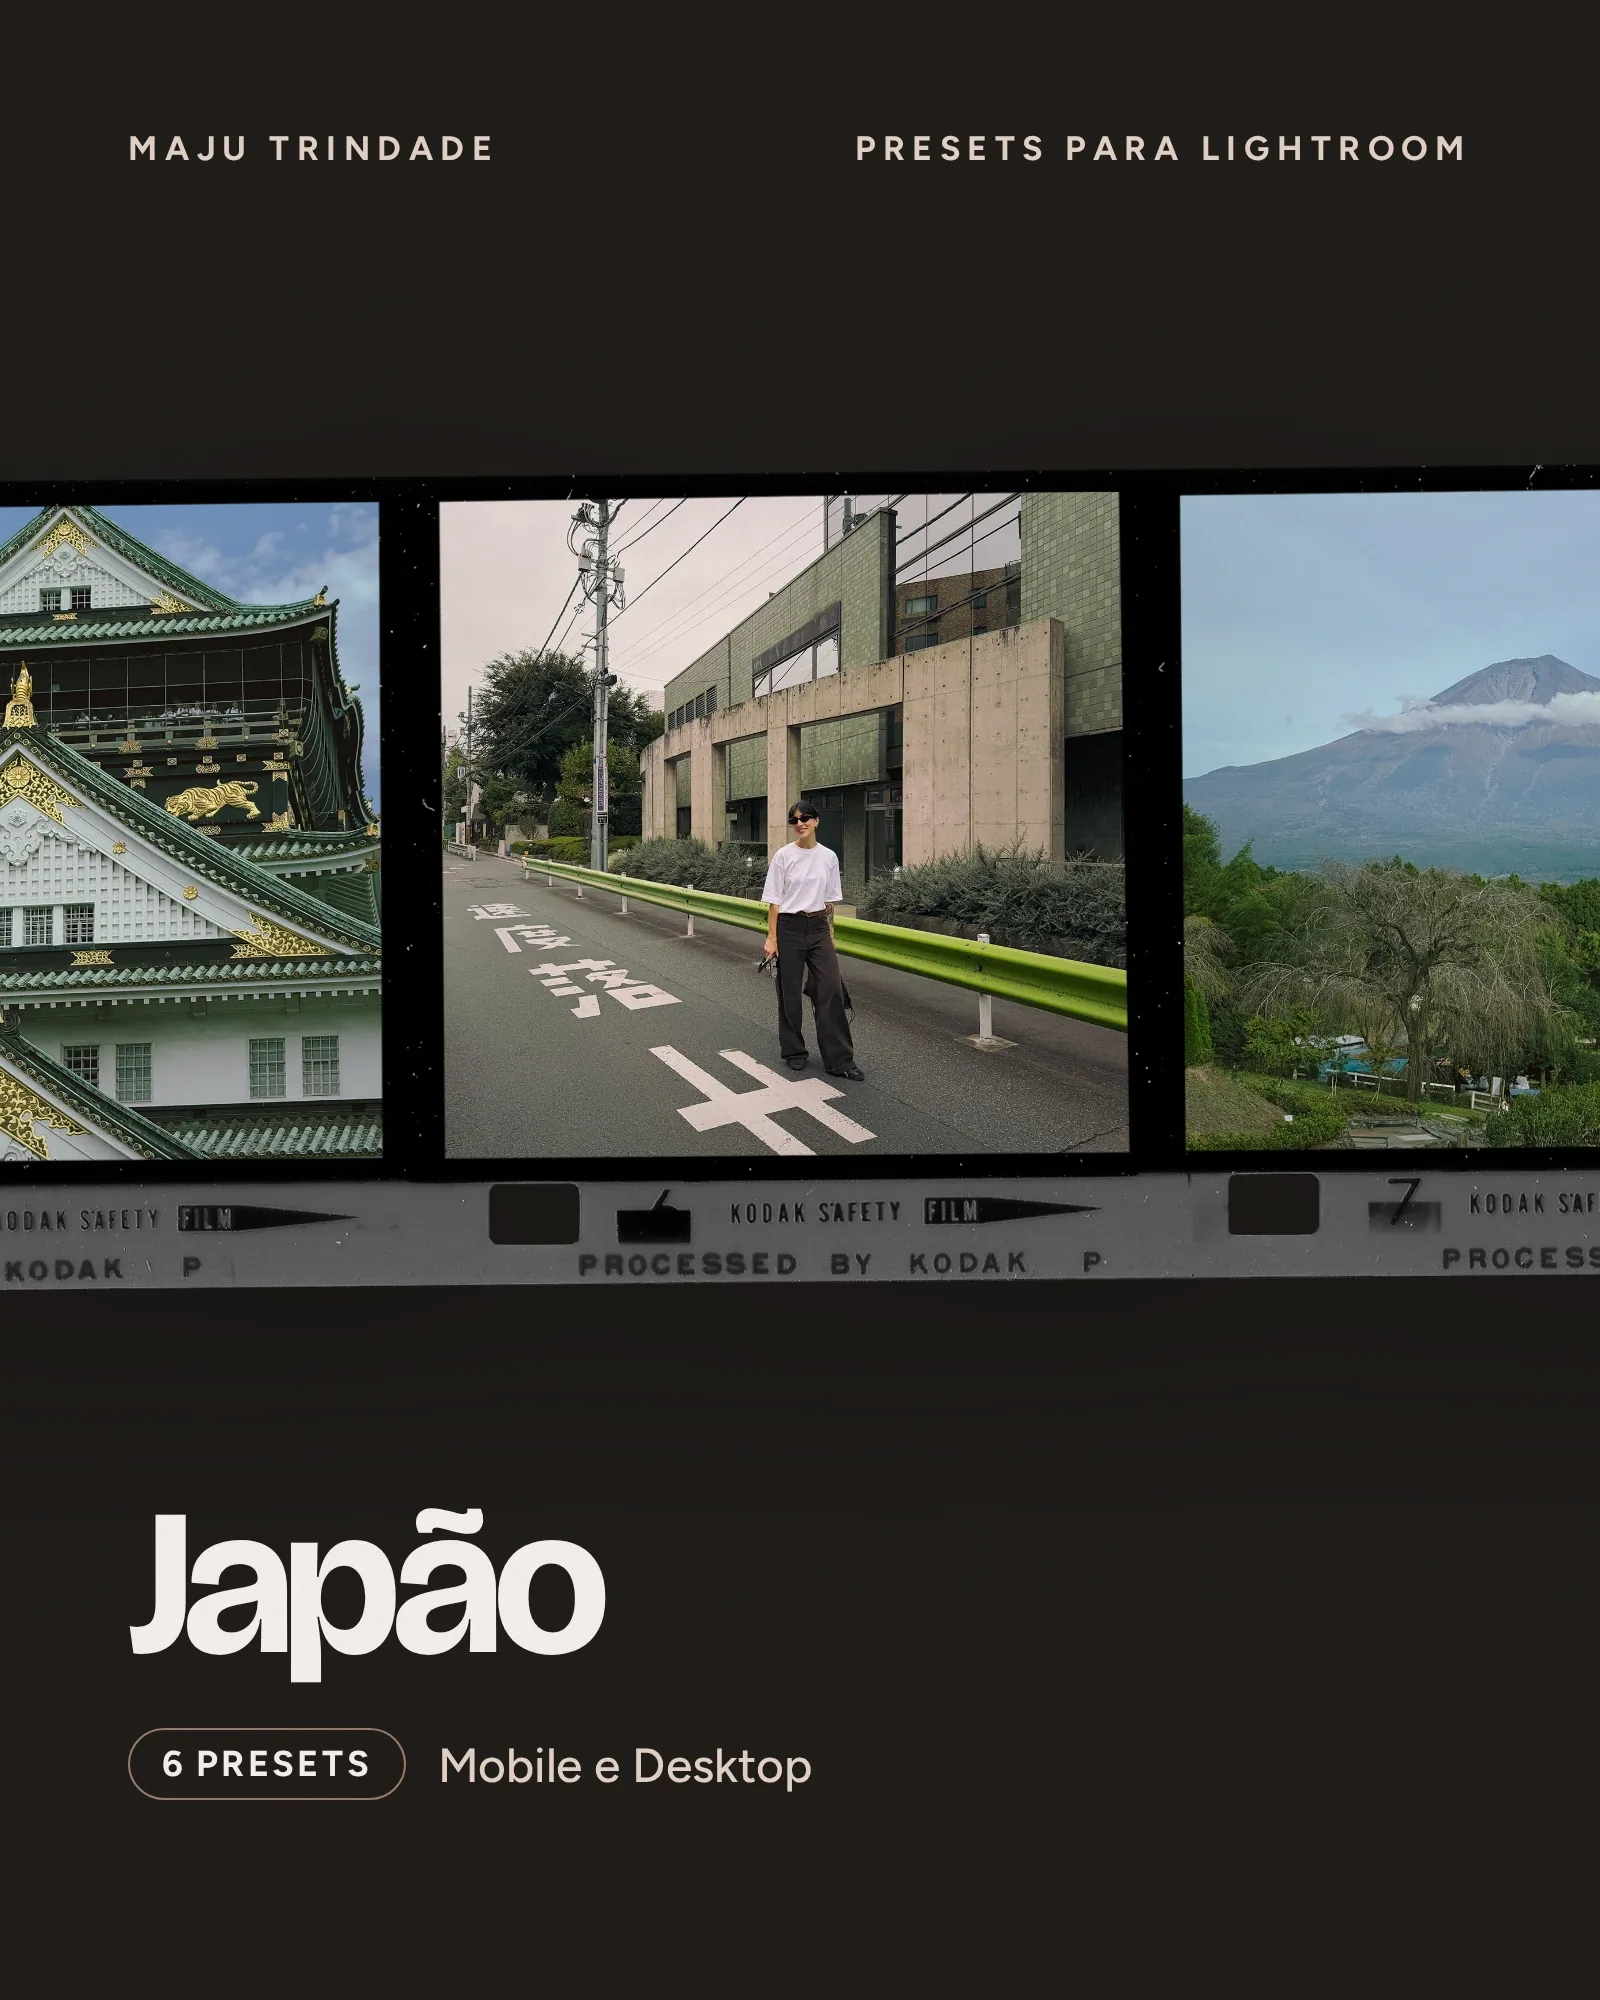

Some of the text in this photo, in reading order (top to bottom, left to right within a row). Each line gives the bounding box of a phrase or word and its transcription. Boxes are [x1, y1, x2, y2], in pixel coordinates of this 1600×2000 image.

[731, 1199, 978, 1224] KODAK SAFETY FILM
[1387, 1177, 1421, 1226] 7
[1470, 1193, 1545, 1214] KODAK
[0, 1207, 232, 1233] ODAK SAFETY FILM
[5, 1256, 202, 1282] KODAK P
[578, 1251, 1102, 1277] PROCESSED BY KODAK P
[1442, 1246, 1600, 1270] PROCESS
